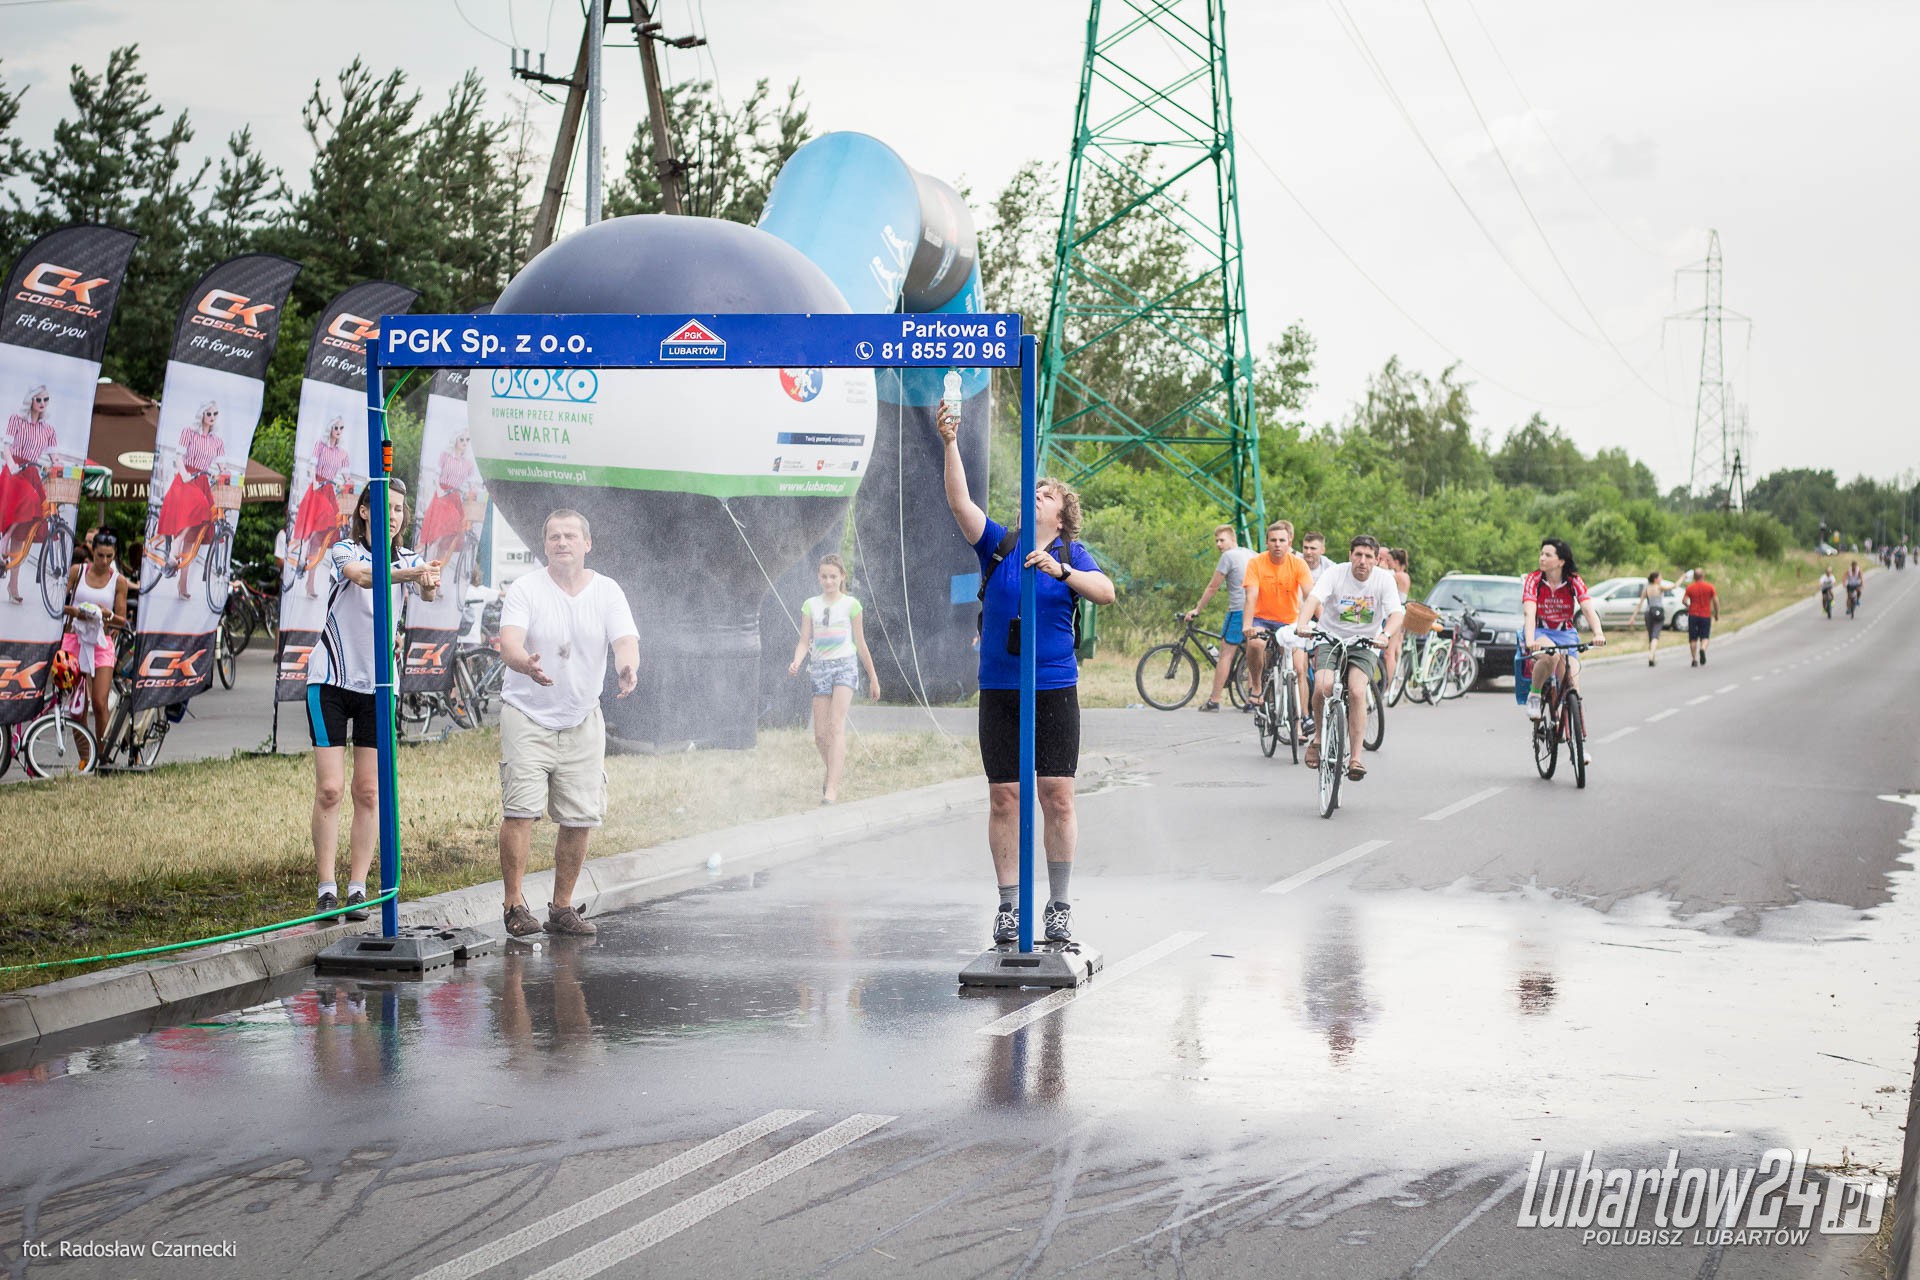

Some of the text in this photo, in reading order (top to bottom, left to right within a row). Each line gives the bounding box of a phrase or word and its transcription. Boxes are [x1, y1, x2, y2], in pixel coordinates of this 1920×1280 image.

[15, 291, 102, 318] COSSACK
[15, 313, 87, 338] Fit for you
[190, 314, 268, 340] COSSACK
[902, 320, 1007, 338] Parkowa 6
[388, 328, 593, 359] PGK Sp. z o.o.
[684, 331, 703, 340] PGK
[190, 335, 254, 359] Fit for you
[668, 345, 718, 356] LUBARTÓW
[881, 342, 1006, 359] 81 855 20 96
[321, 355, 338, 367] Fit
[338, 358, 355, 371] for
[446, 372, 463, 384] Fit
[491, 407, 594, 426] ROWEREM PRZEZ KRAINĘ
[507, 424, 571, 445] LEWARTA
[507, 466, 587, 482] www.lubartow.pl
[135, 672, 207, 690] COSSACK
